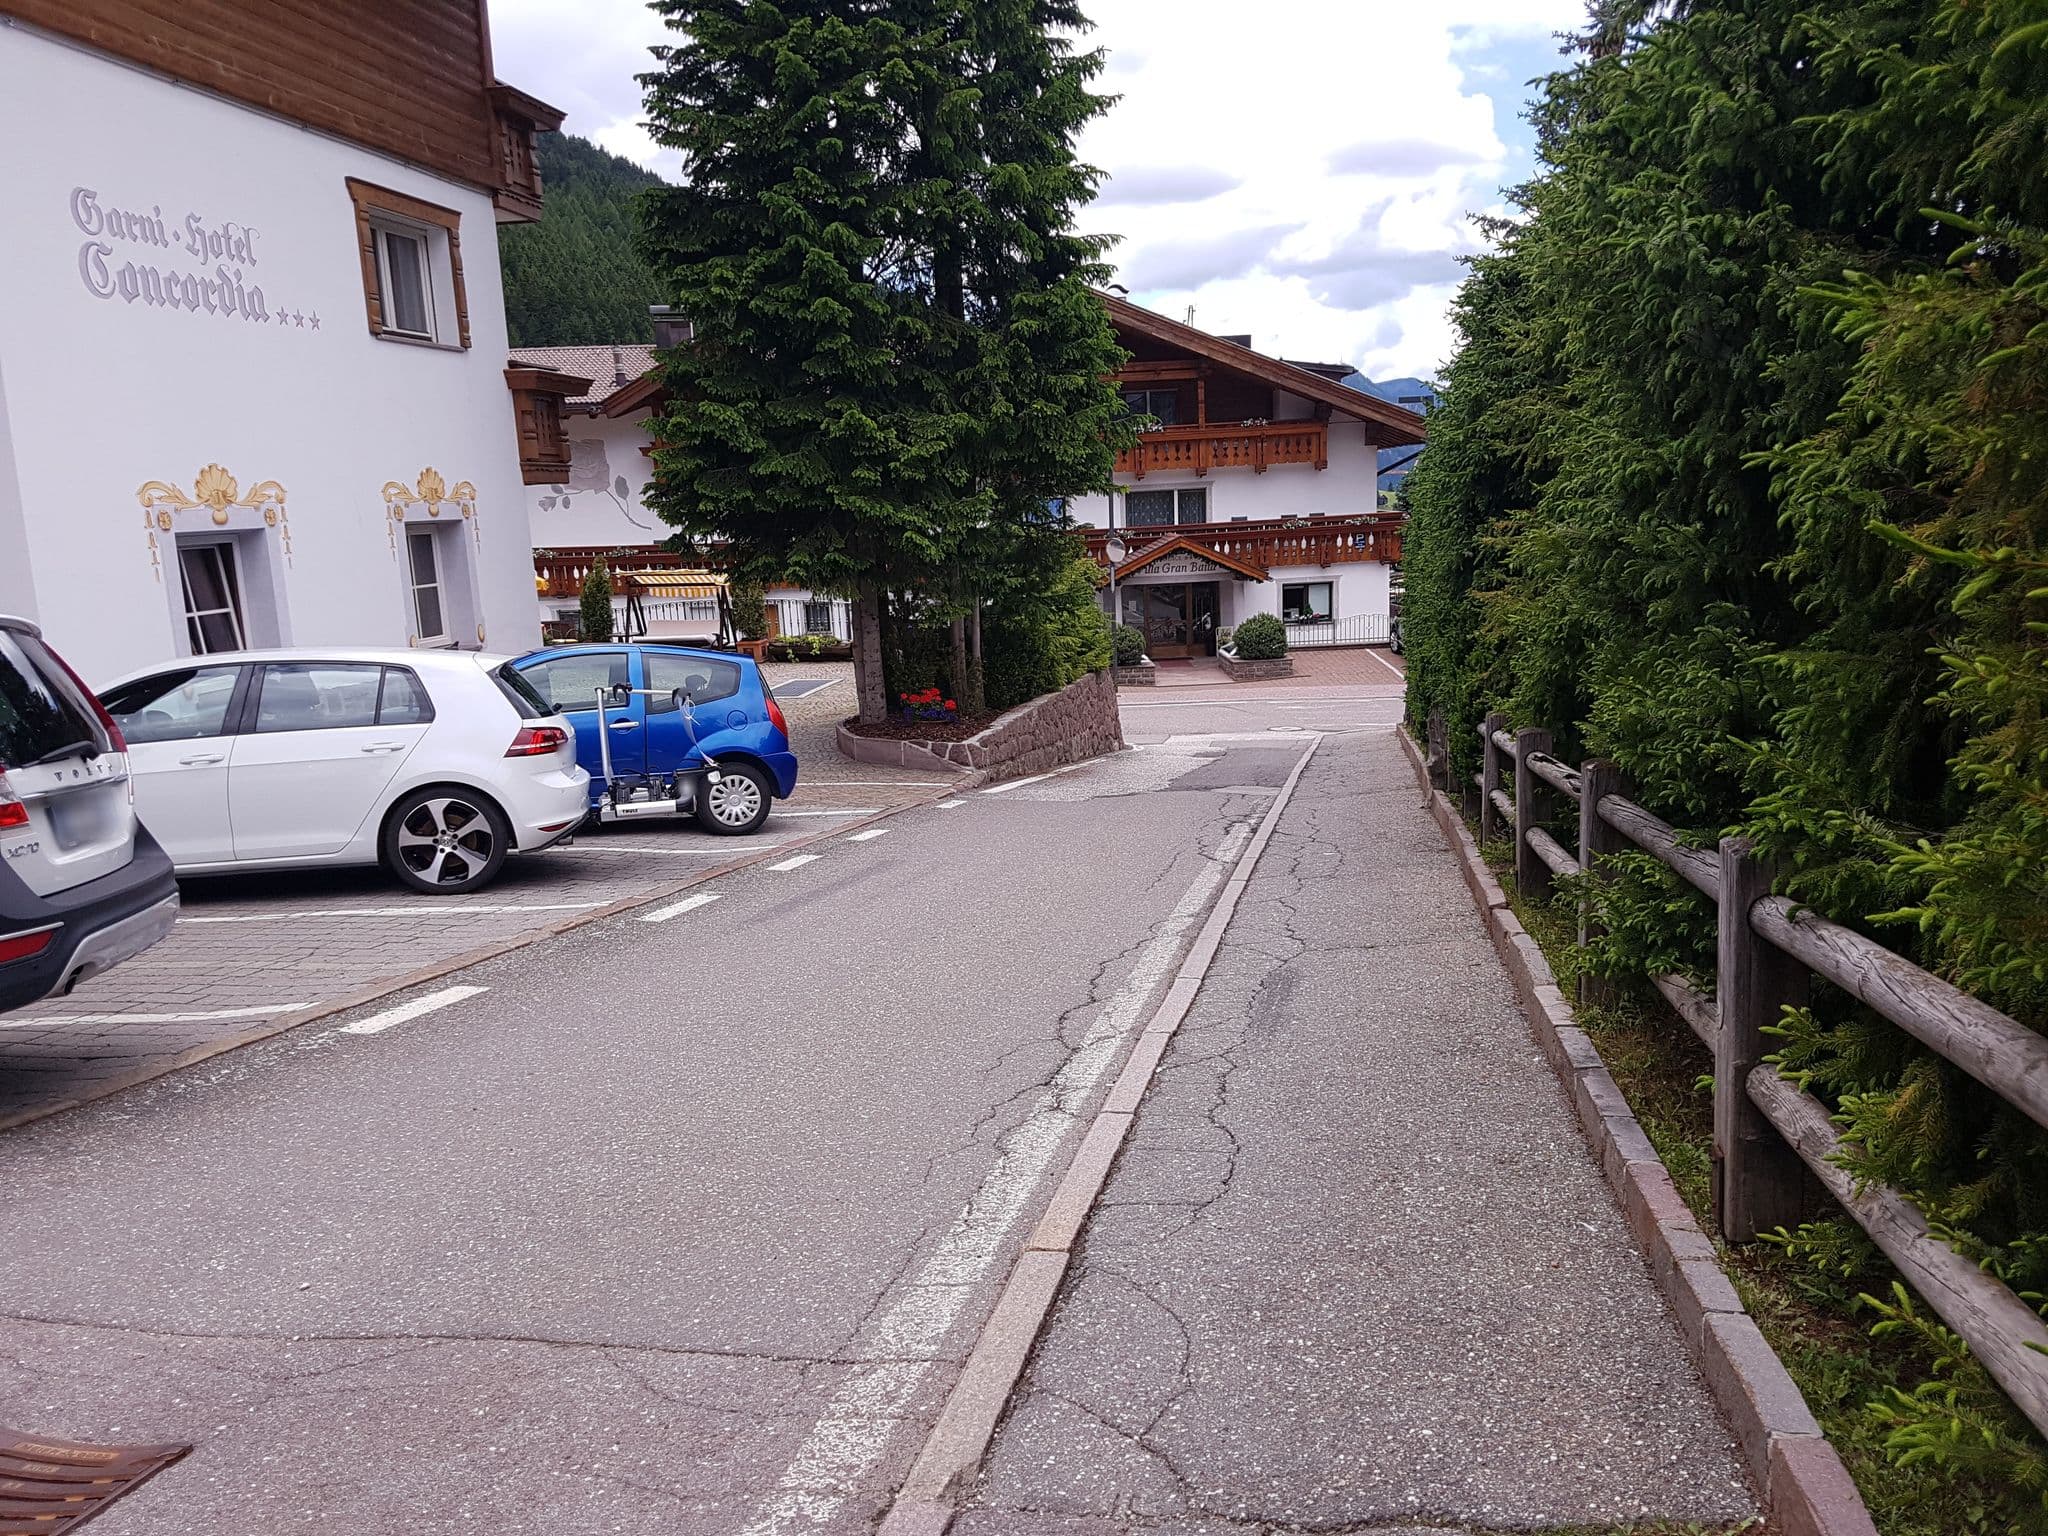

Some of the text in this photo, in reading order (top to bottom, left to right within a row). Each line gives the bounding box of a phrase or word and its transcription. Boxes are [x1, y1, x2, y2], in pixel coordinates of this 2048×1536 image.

[70, 186, 261, 267] Garni Hotel
[78, 240, 270, 323] Concordia
[1162, 562, 1188, 573] Gran
